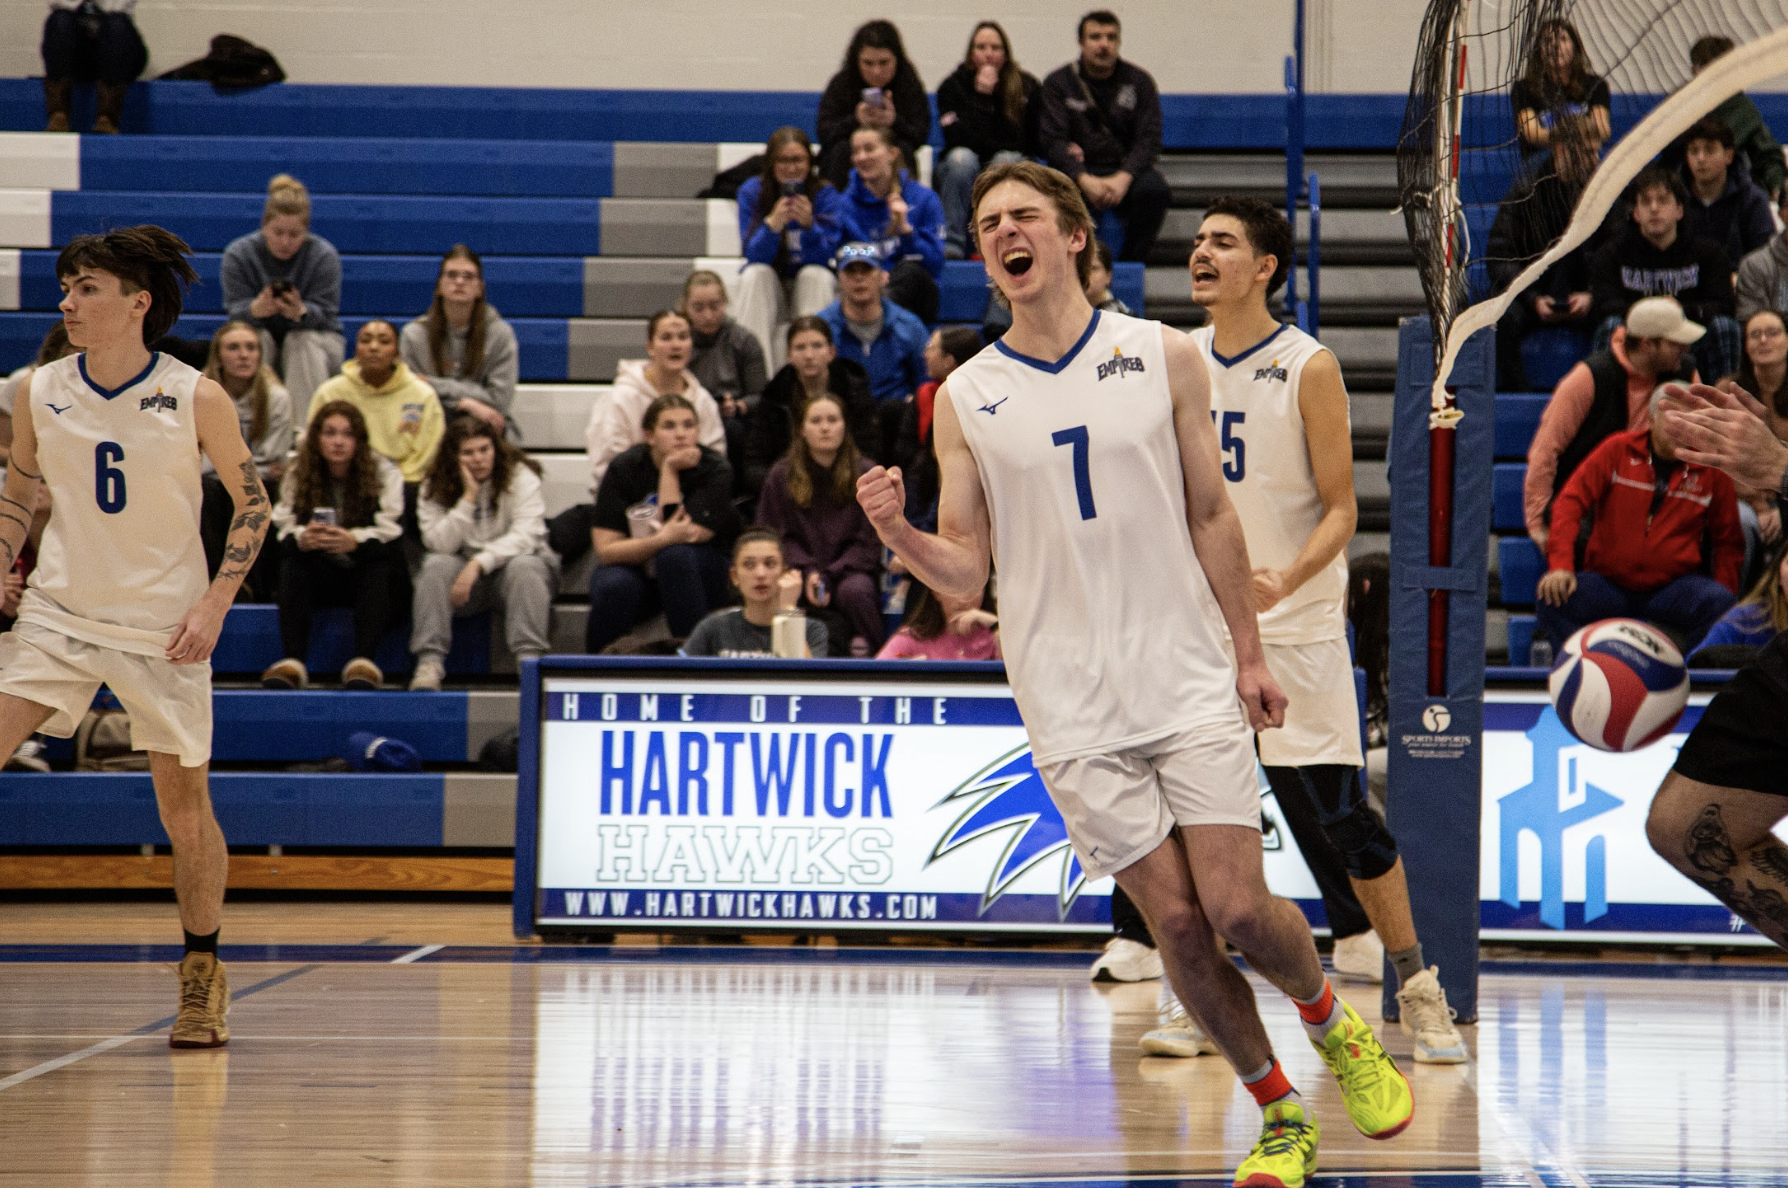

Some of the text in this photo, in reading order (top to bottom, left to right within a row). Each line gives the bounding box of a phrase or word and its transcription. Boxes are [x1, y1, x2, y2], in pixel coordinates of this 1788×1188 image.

[95, 441, 127, 514] 6
[1051, 425, 1097, 521] 7
[1210, 409, 1246, 483] 5
[562, 692, 947, 725] HOME OF THE
[600, 730, 894, 819] HARTWICK
[596, 824, 893, 885] HAWKS
[564, 891, 937, 920] WWW.HARTWICKHAWKS.COM
